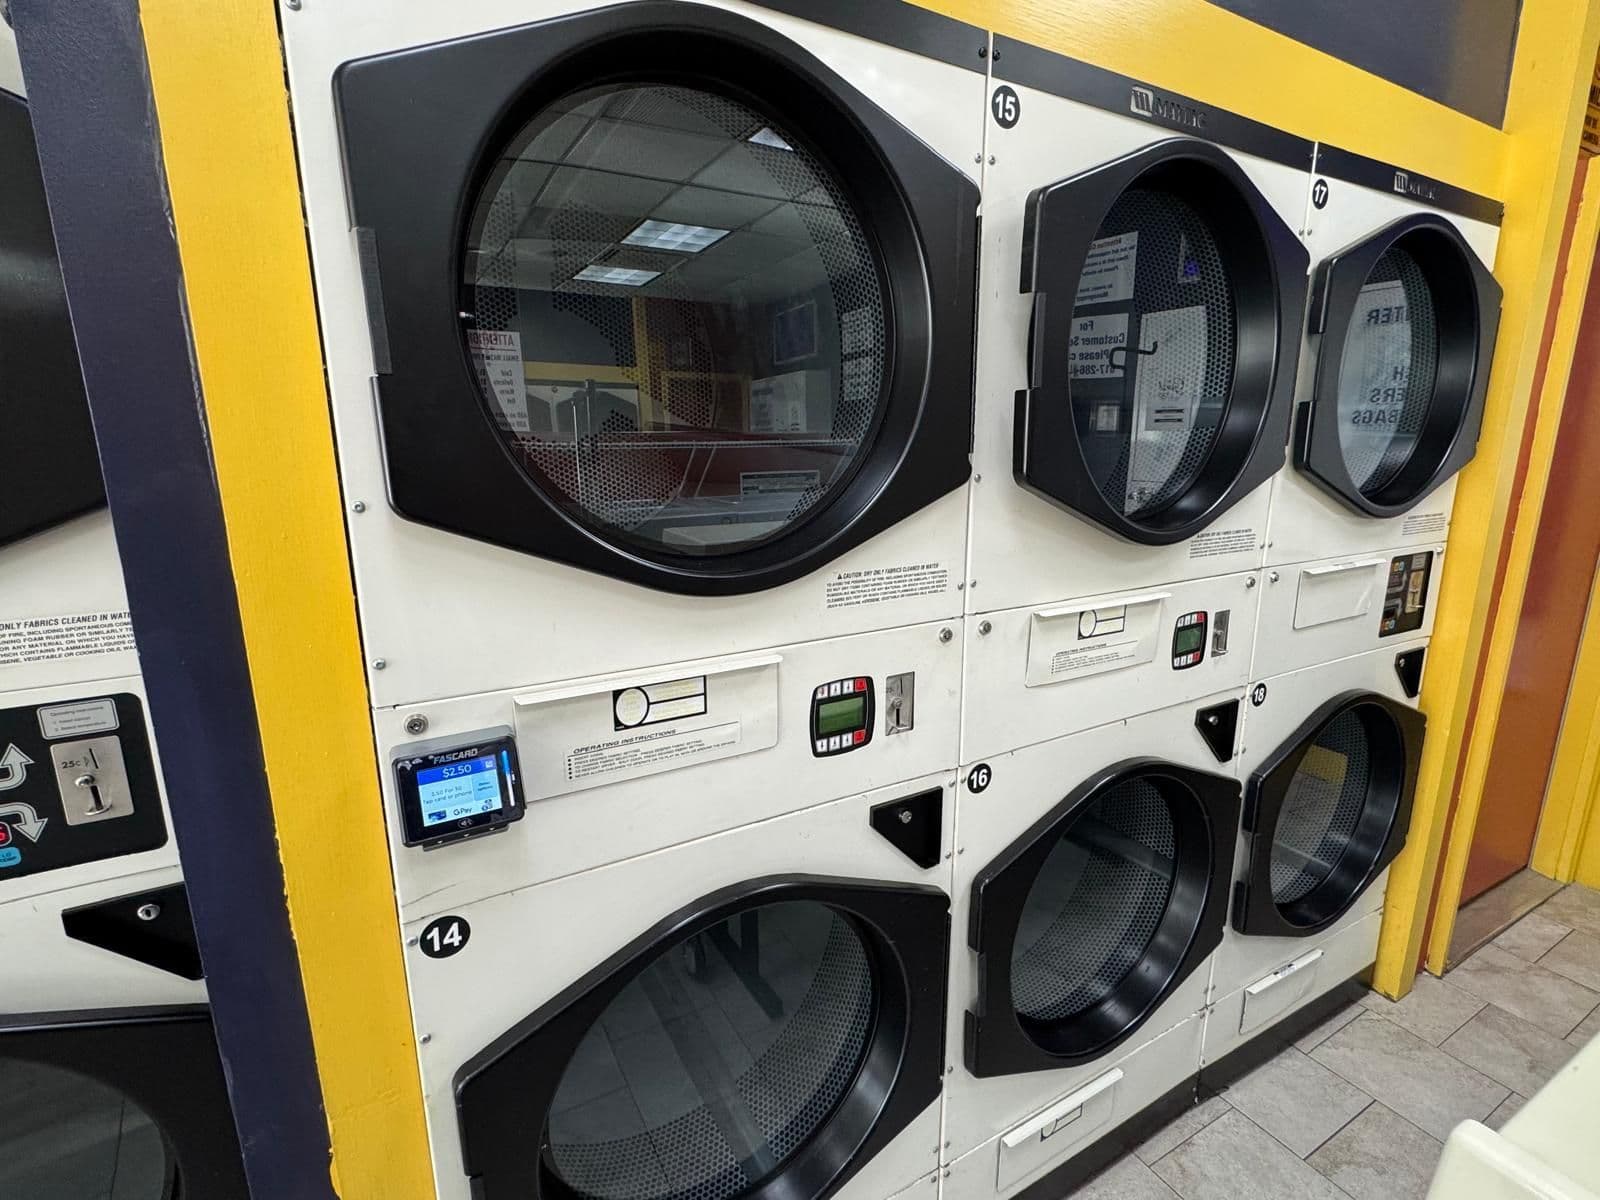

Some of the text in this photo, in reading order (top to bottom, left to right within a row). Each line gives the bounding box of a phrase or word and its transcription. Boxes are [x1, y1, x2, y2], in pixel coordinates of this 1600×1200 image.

[995, 93, 1016, 122] 15
[1314, 183, 1328, 205] 17
[0, 621, 21, 631] ONLY
[23, 618, 60, 629] FABRICS
[61, 614, 98, 625] CLEANED
[99, 613, 109, 621] IN
[65, 623, 114, 633] SPONTANEOUS
[23, 635, 44, 643] FOAM
[46, 631, 75, 640] RUBBER
[88, 626, 123, 636] SIMILARLY
[28, 639, 64, 649] MATERIAL
[1255, 687, 1265, 703] 18
[573, 728, 676, 754] OPERATING INSTRUCTIONS
[433, 748, 478, 765] FASCARD
[442, 764, 472, 778] $2.50
[970, 768, 988, 788] 16
[426, 922, 463, 952] 14
